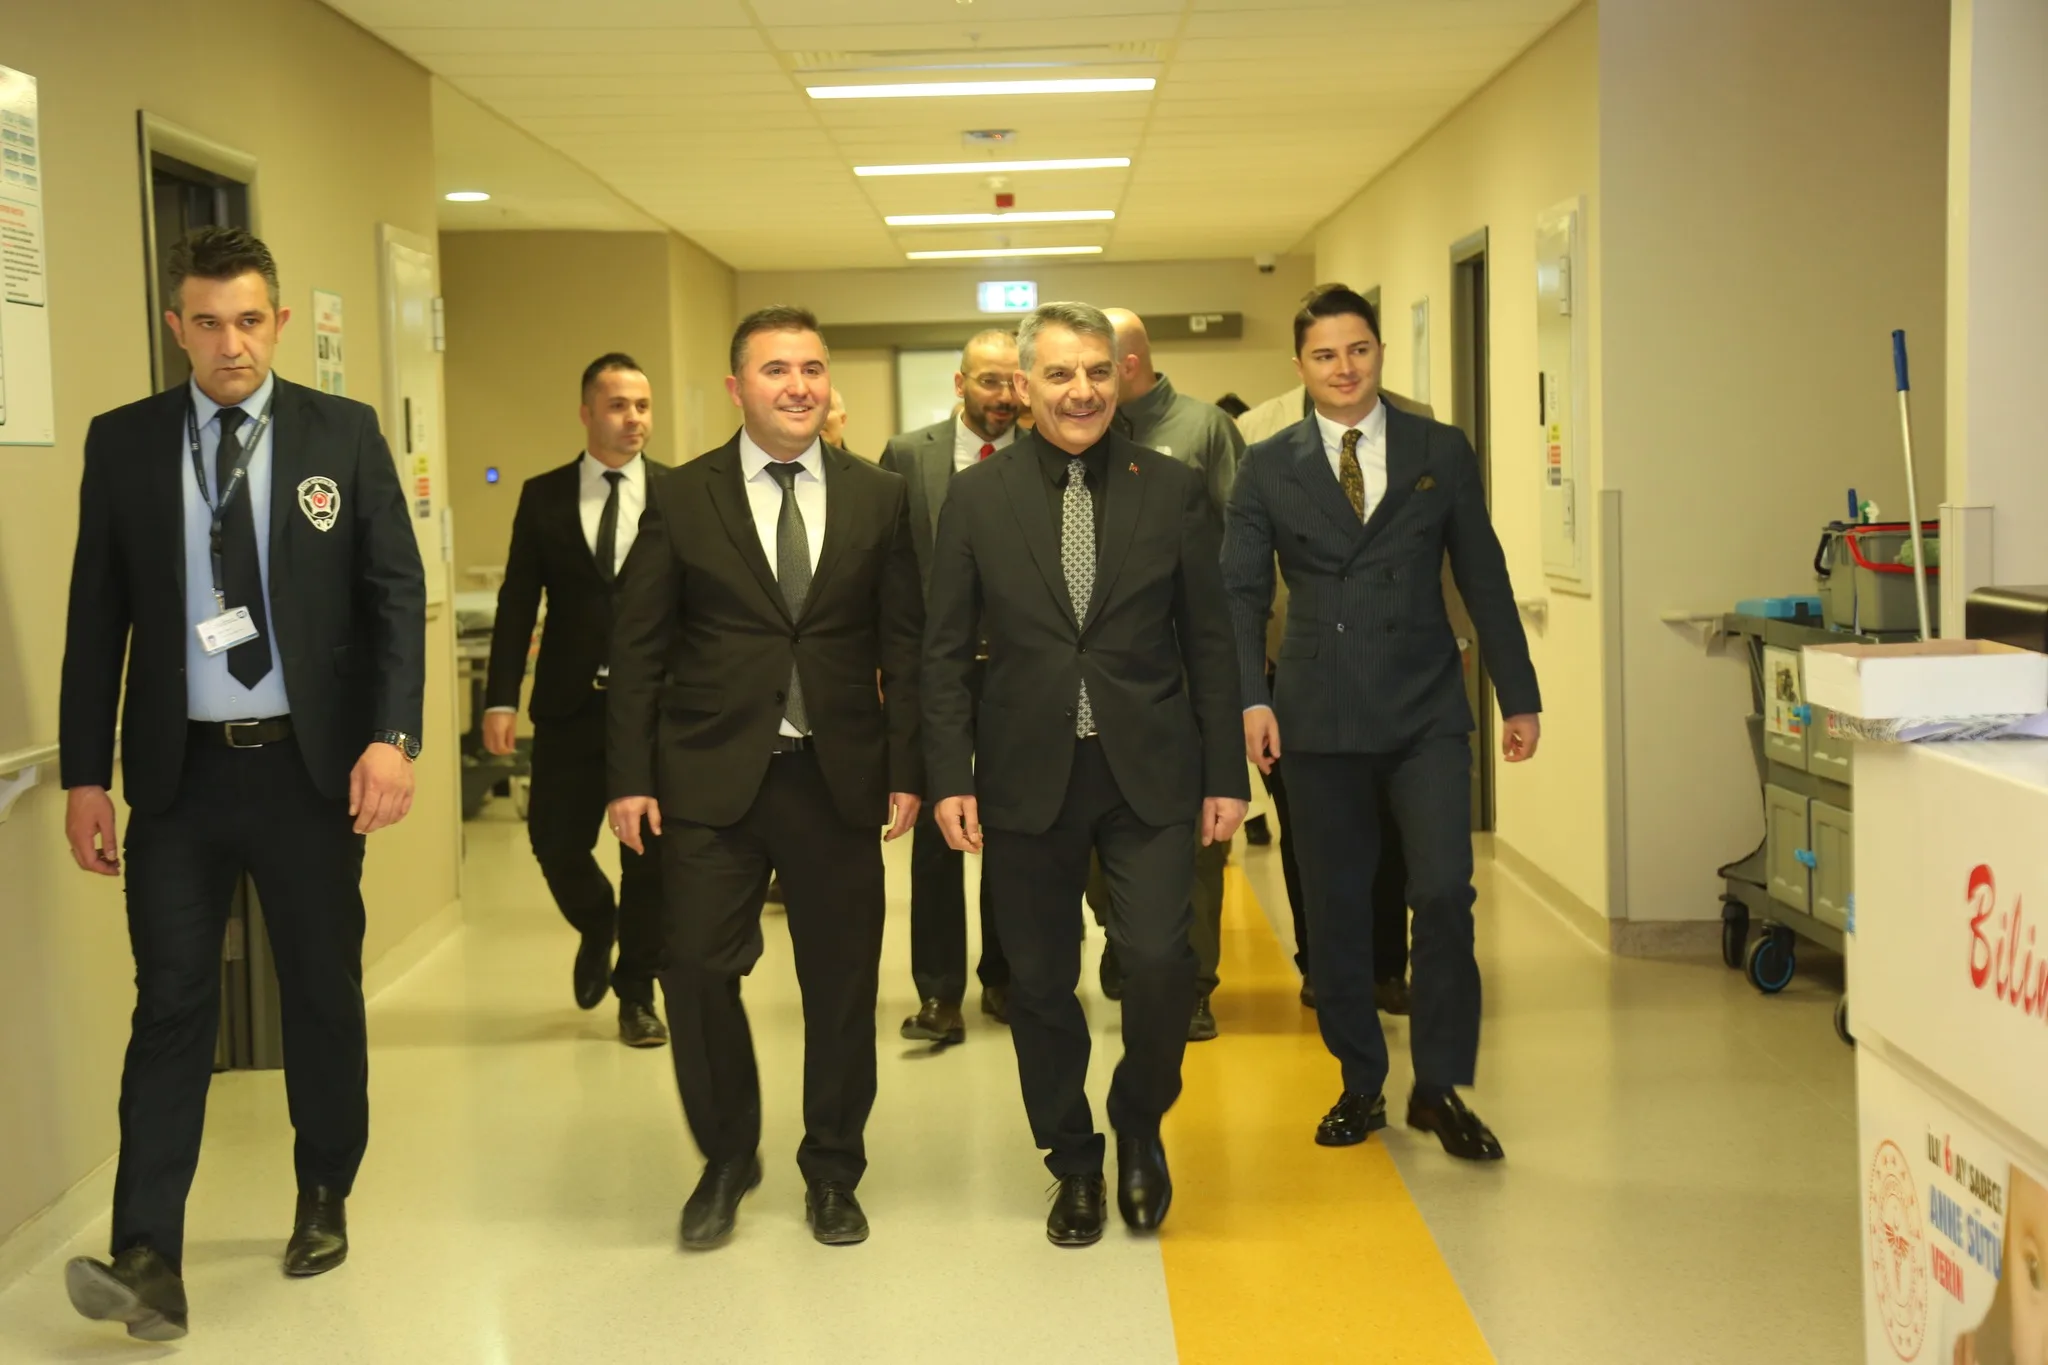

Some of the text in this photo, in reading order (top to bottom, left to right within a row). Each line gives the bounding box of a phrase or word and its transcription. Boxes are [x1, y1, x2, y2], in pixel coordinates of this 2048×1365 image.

[1944, 1133, 1953, 1176] 6
[1955, 1154, 1967, 1187] AY
[1930, 1184, 1963, 1249] ANNE
[1967, 1207, 2002, 1281] SÜTÜ
